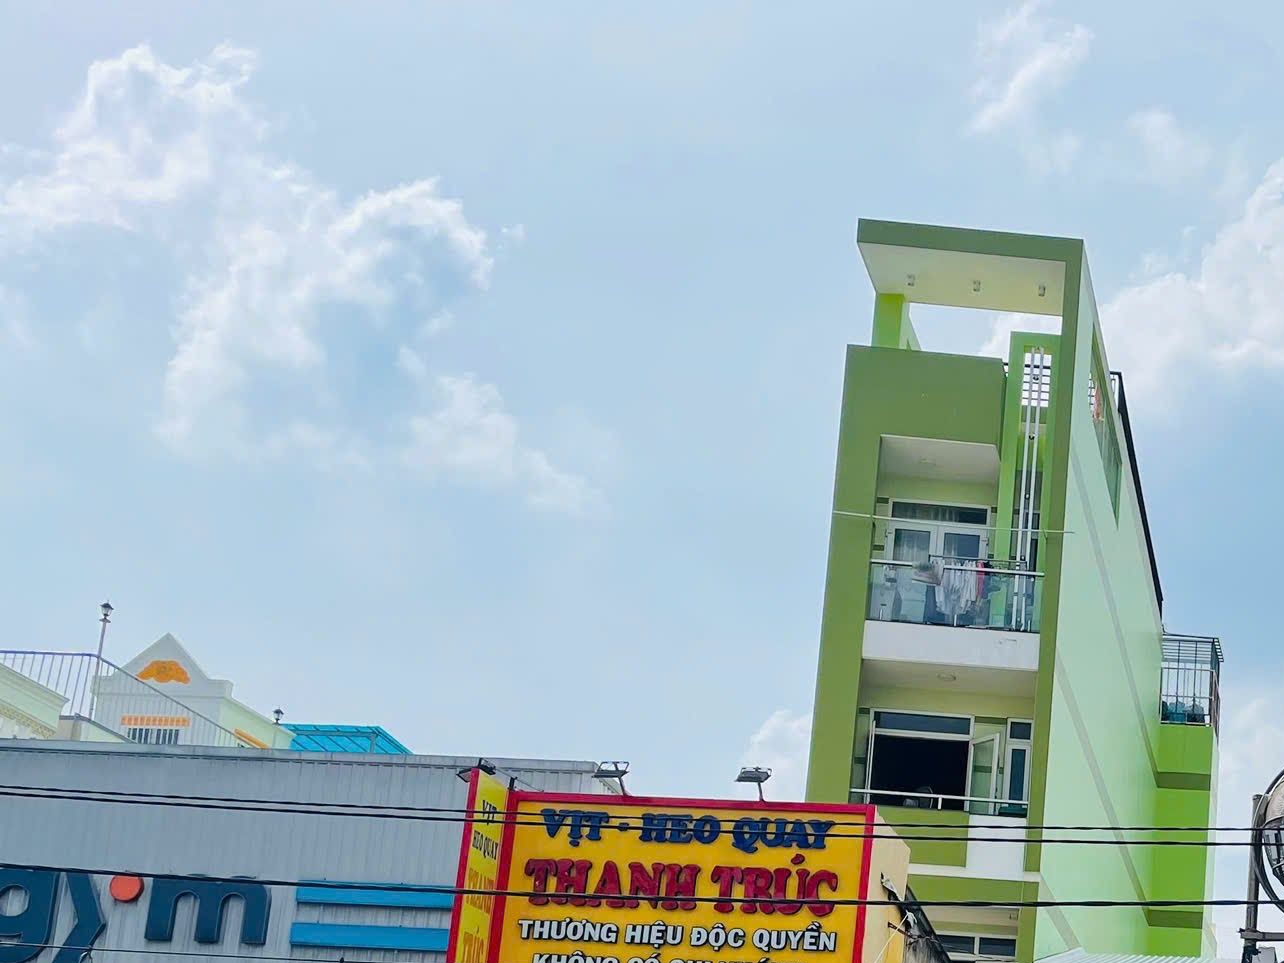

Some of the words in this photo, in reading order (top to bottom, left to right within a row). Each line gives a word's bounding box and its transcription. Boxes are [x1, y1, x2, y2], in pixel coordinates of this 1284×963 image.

[639, 813, 721, 844] HEO
[732, 817, 835, 854] QUAY
[524, 858, 700, 911] THANH
[711, 854, 839, 917] TRÚC
[518, 918, 618, 945] THƯƠNG
[624, 920, 683, 947] HIỆU
[690, 922, 745, 949] ĐỘC
[752, 920, 837, 952] QUYỀN
